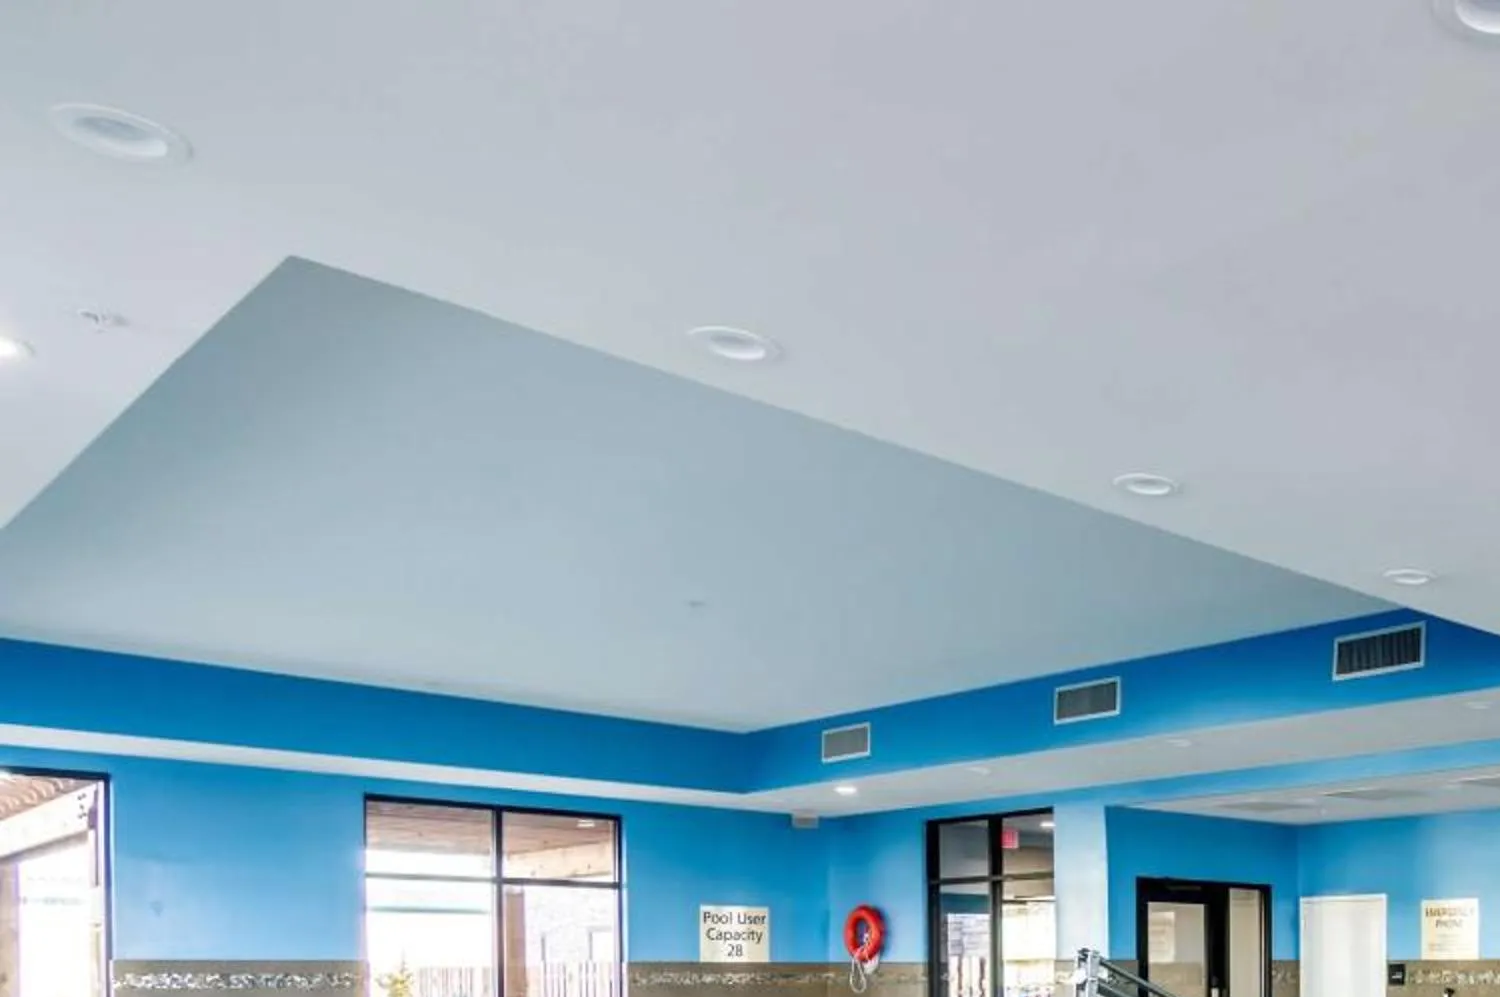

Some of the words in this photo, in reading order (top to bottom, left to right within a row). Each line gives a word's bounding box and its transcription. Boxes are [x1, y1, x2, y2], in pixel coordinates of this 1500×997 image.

[703, 911, 732, 925] Pool
[737, 911, 767, 925] User
[705, 927, 763, 944] Capacity
[727, 943, 744, 957] 28
